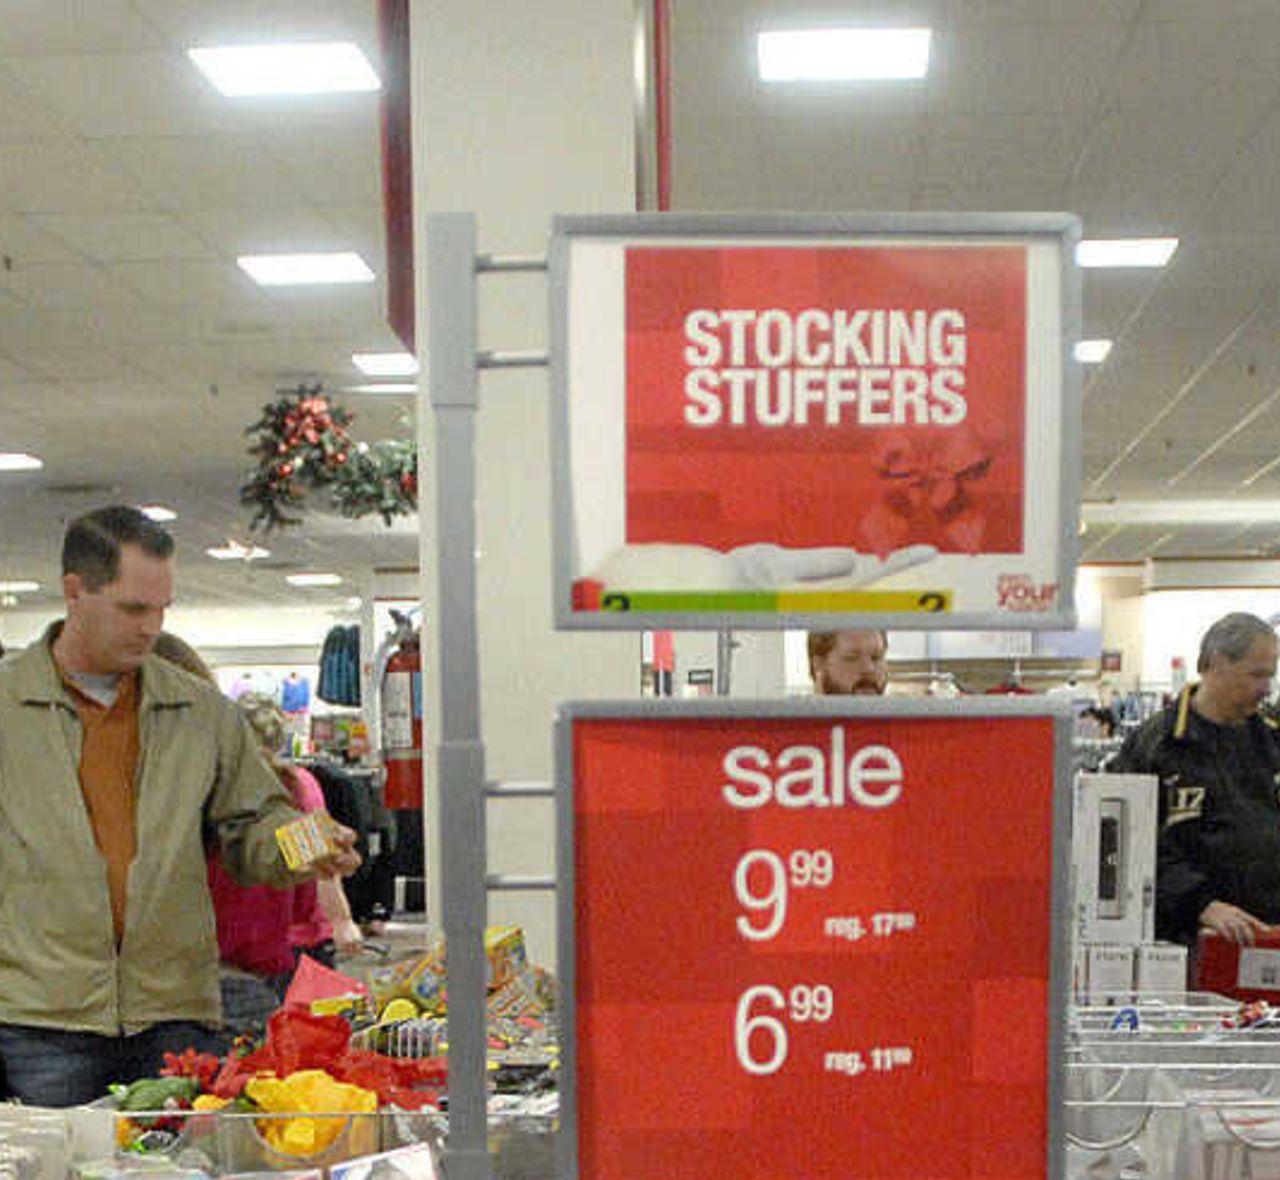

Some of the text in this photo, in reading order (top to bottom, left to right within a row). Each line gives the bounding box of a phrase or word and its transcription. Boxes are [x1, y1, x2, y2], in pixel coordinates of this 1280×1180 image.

[683, 310, 967, 366] STOCKING
[683, 370, 967, 425] STUFFERS
[721, 727, 904, 808] sale
